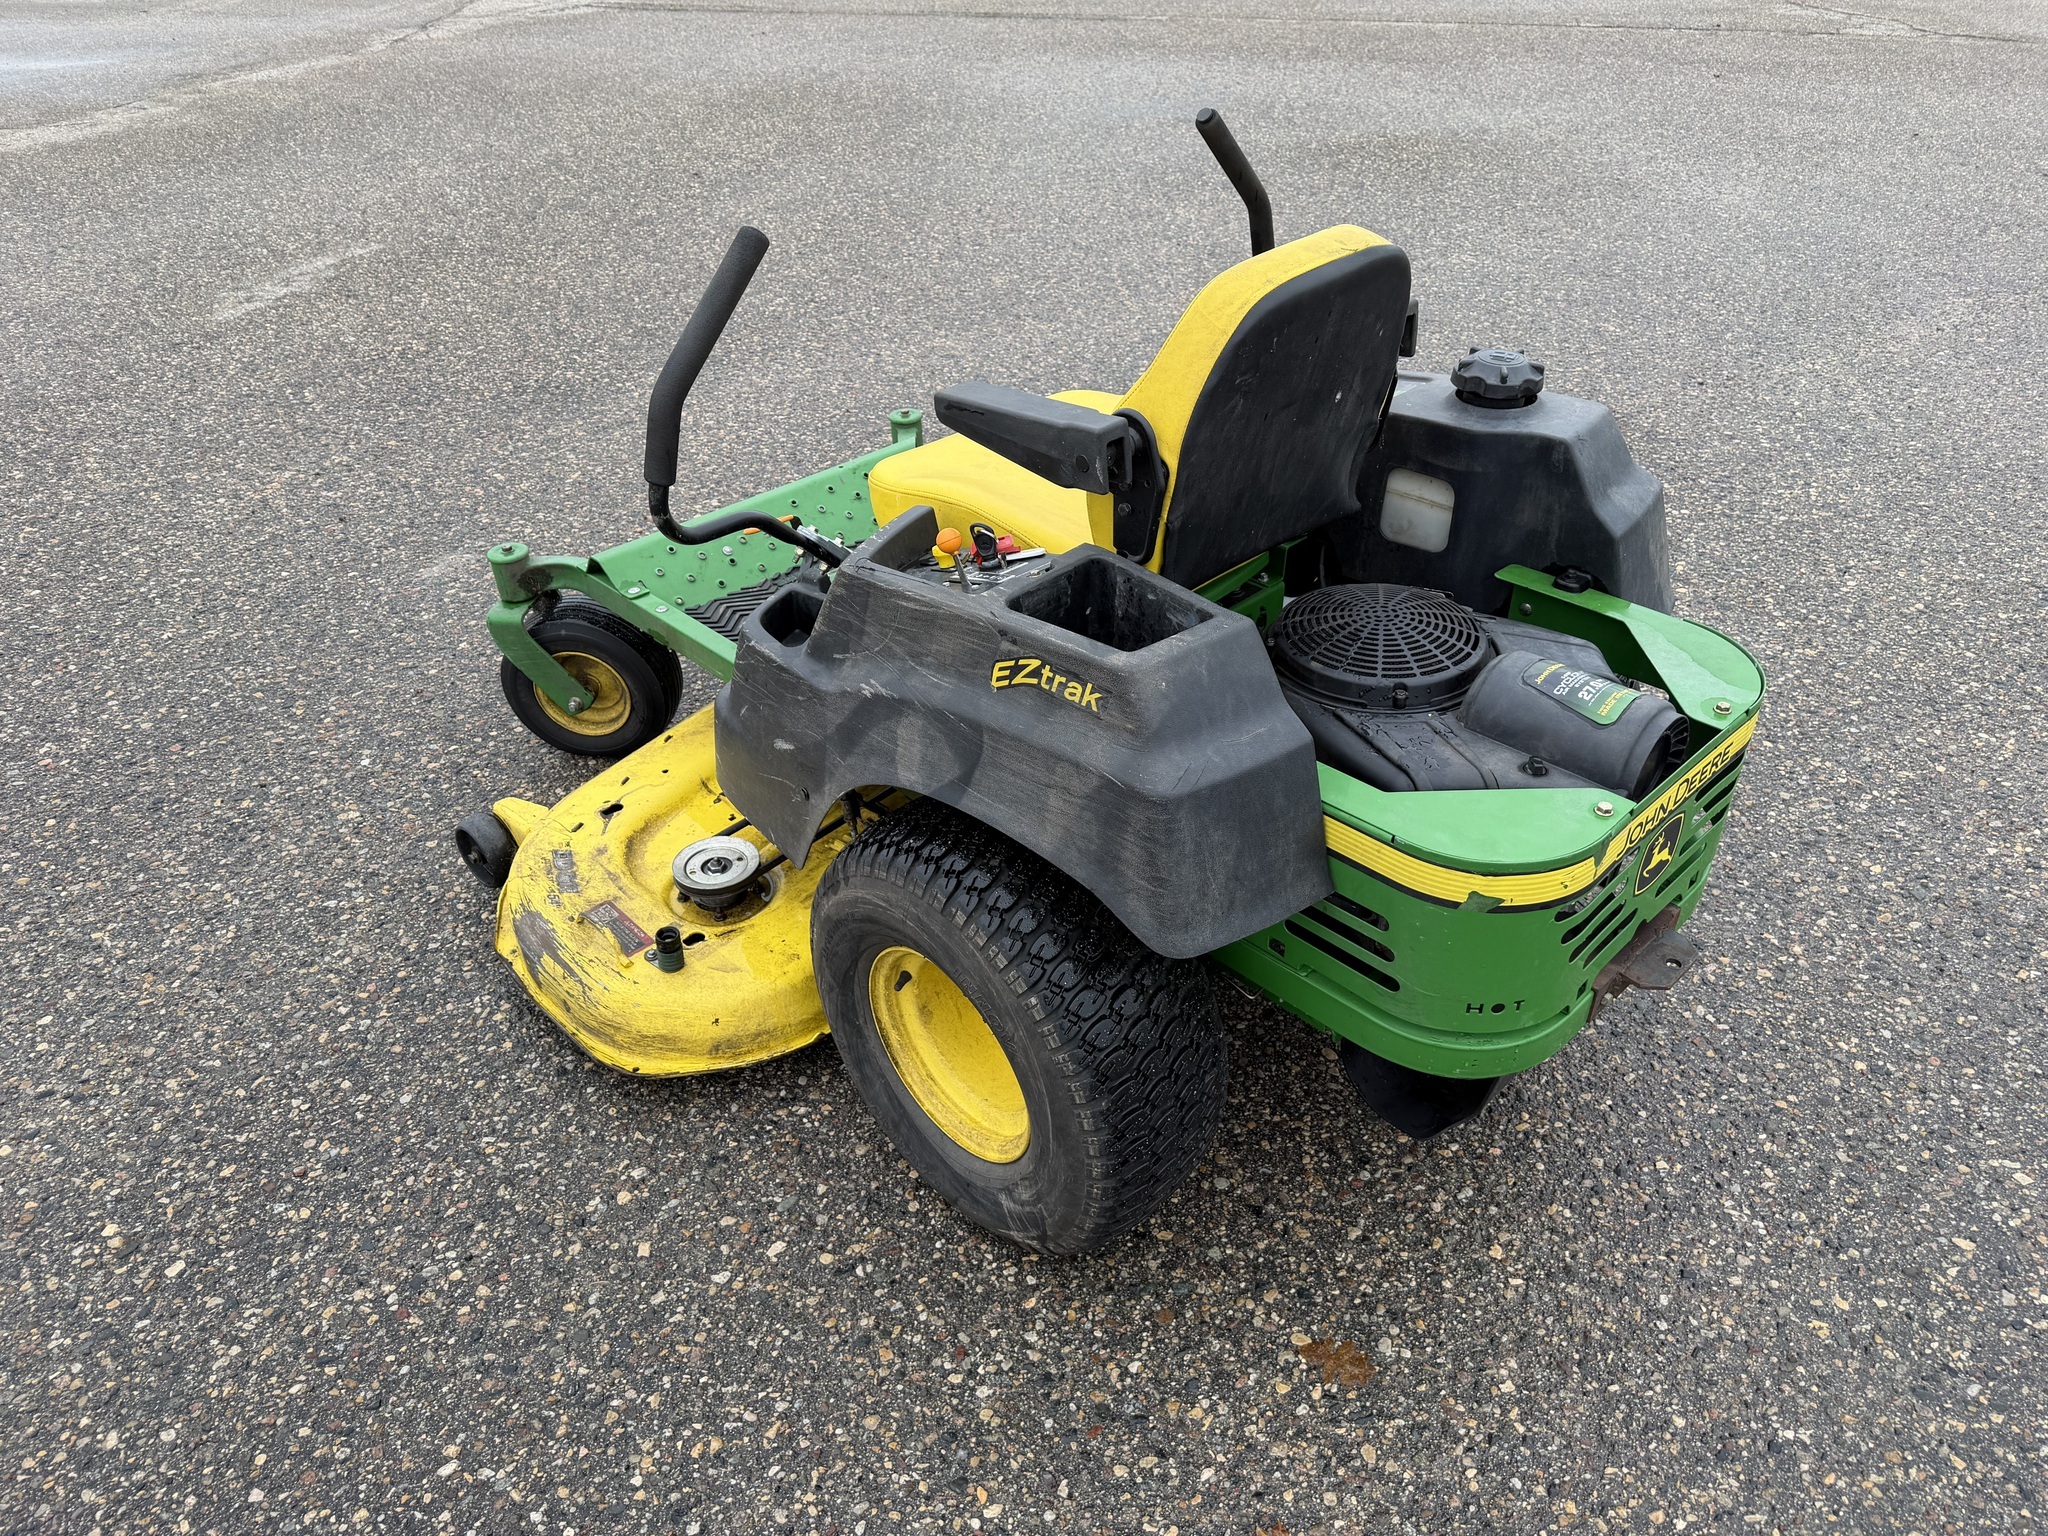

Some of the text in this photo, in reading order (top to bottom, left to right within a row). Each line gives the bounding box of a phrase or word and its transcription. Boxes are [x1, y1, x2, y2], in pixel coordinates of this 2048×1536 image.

[992, 659, 1102, 712] EZtrak
[1617, 741, 1734, 858] JOHN DEERE
[1465, 1000, 1525, 1014] HOT
